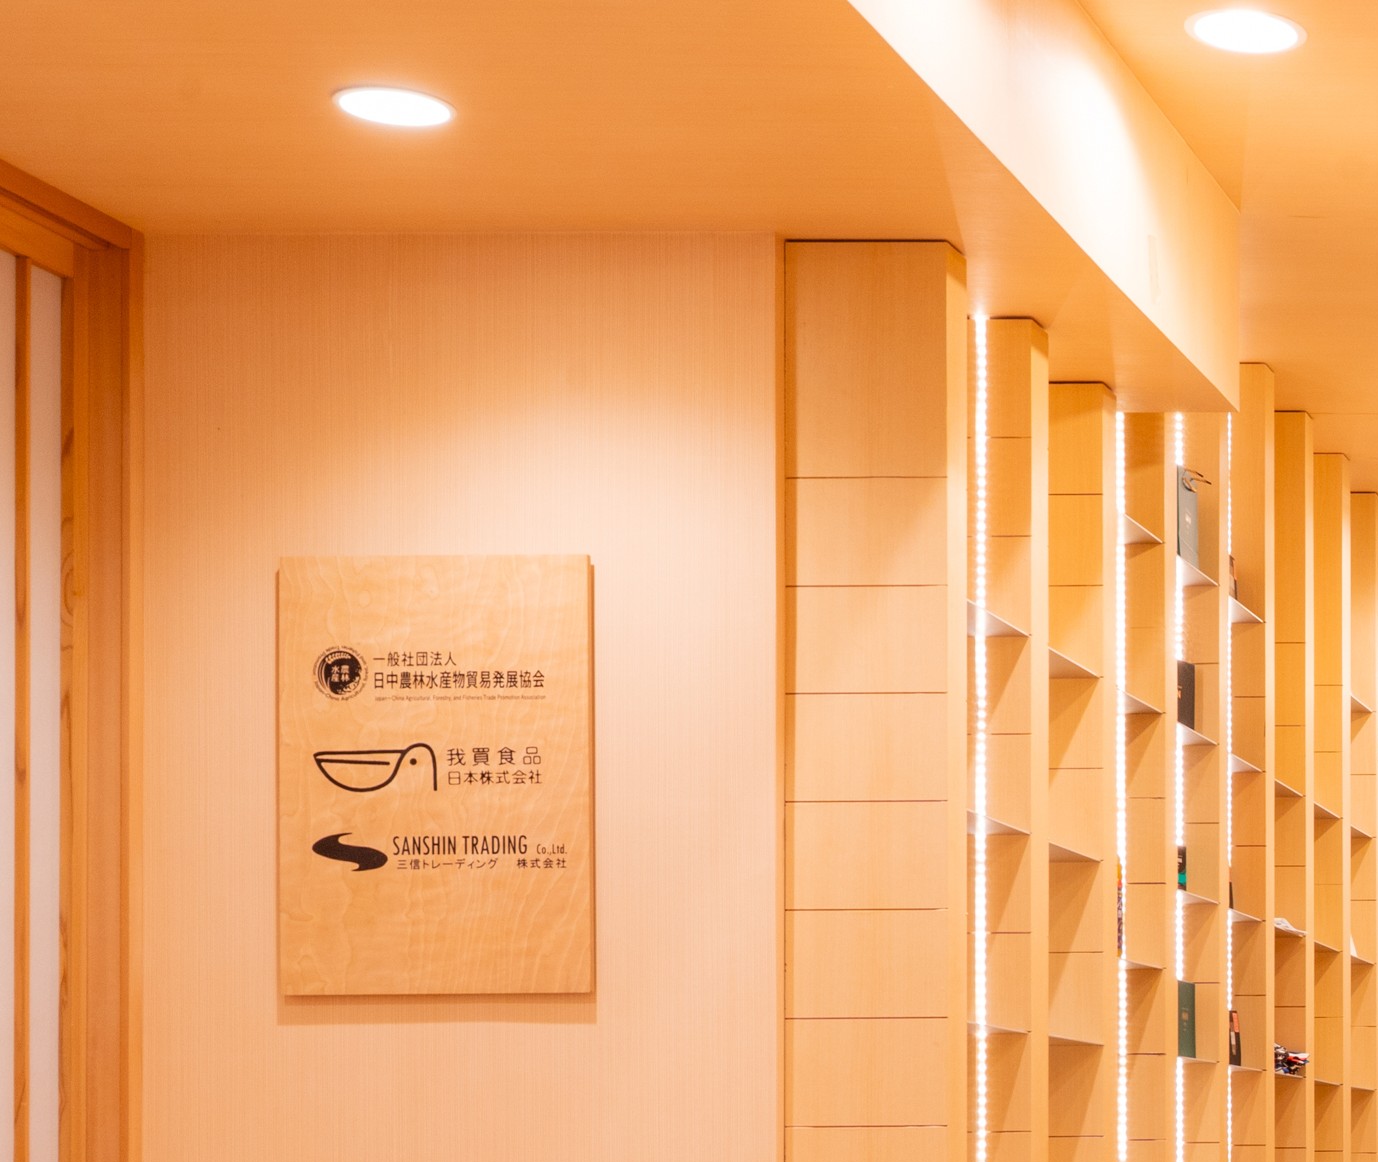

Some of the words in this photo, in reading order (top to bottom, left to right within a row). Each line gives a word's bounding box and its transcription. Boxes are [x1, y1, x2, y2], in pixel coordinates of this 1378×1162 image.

[373, 651, 457, 667] 一般社団法人
[373, 669, 545, 689] 日中農林水産物貿易発展協会
[446, 746, 542, 766] 我買食品
[447, 770, 544, 786] 日本株式会社
[392, 835, 457, 856] SANSHIN
[462, 834, 528, 855] TRADING
[536, 843, 568, 856] Co.,Ltd.
[397, 857, 499, 870] 三信トレーディング
[516, 857, 568, 869] 株式会社
